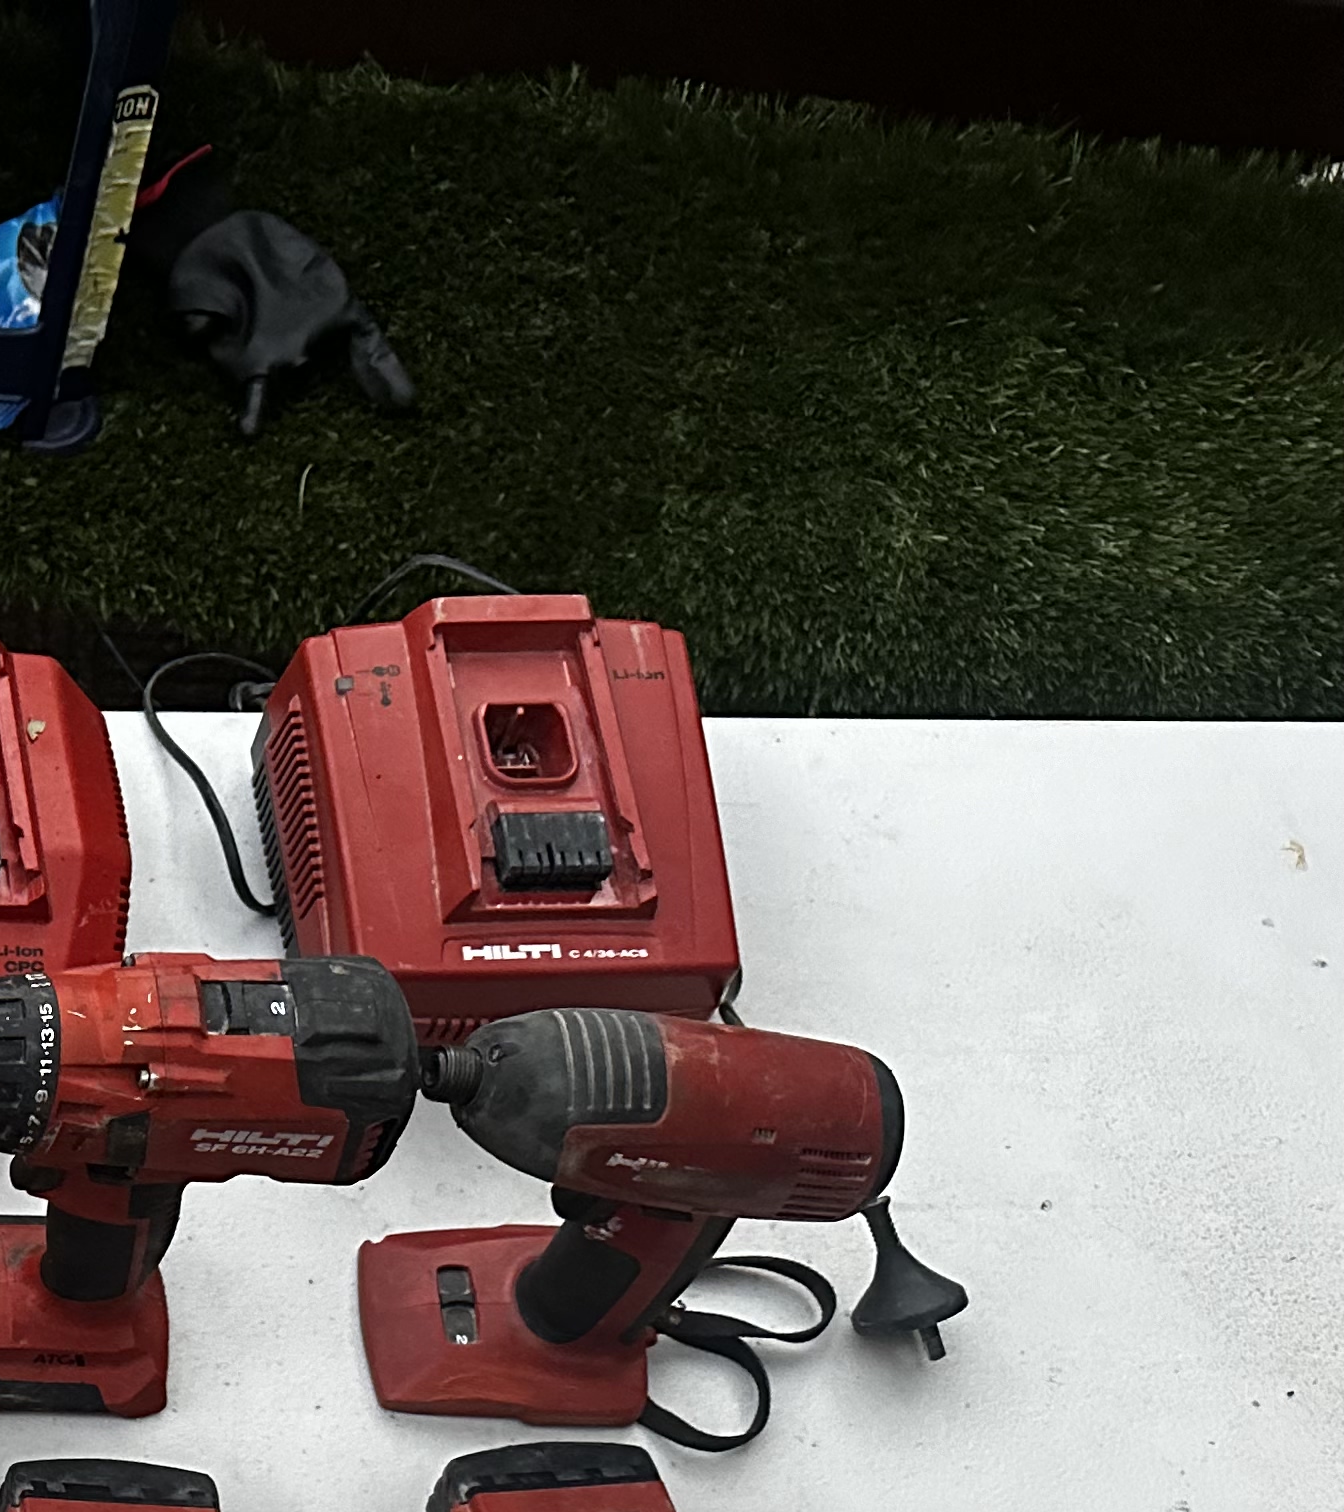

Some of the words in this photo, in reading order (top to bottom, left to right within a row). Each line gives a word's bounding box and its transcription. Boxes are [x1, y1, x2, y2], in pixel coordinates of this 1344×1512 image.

[462, 943, 562, 961] HILTI
[568, 949, 580, 958] C
[4, 961, 45, 973] CPC
[270, 1001, 286, 1016] 2
[190, 1128, 334, 1148] HILTI
[194, 1143, 228, 1153] SF
[231, 1145, 324, 1159] 6H-A22
